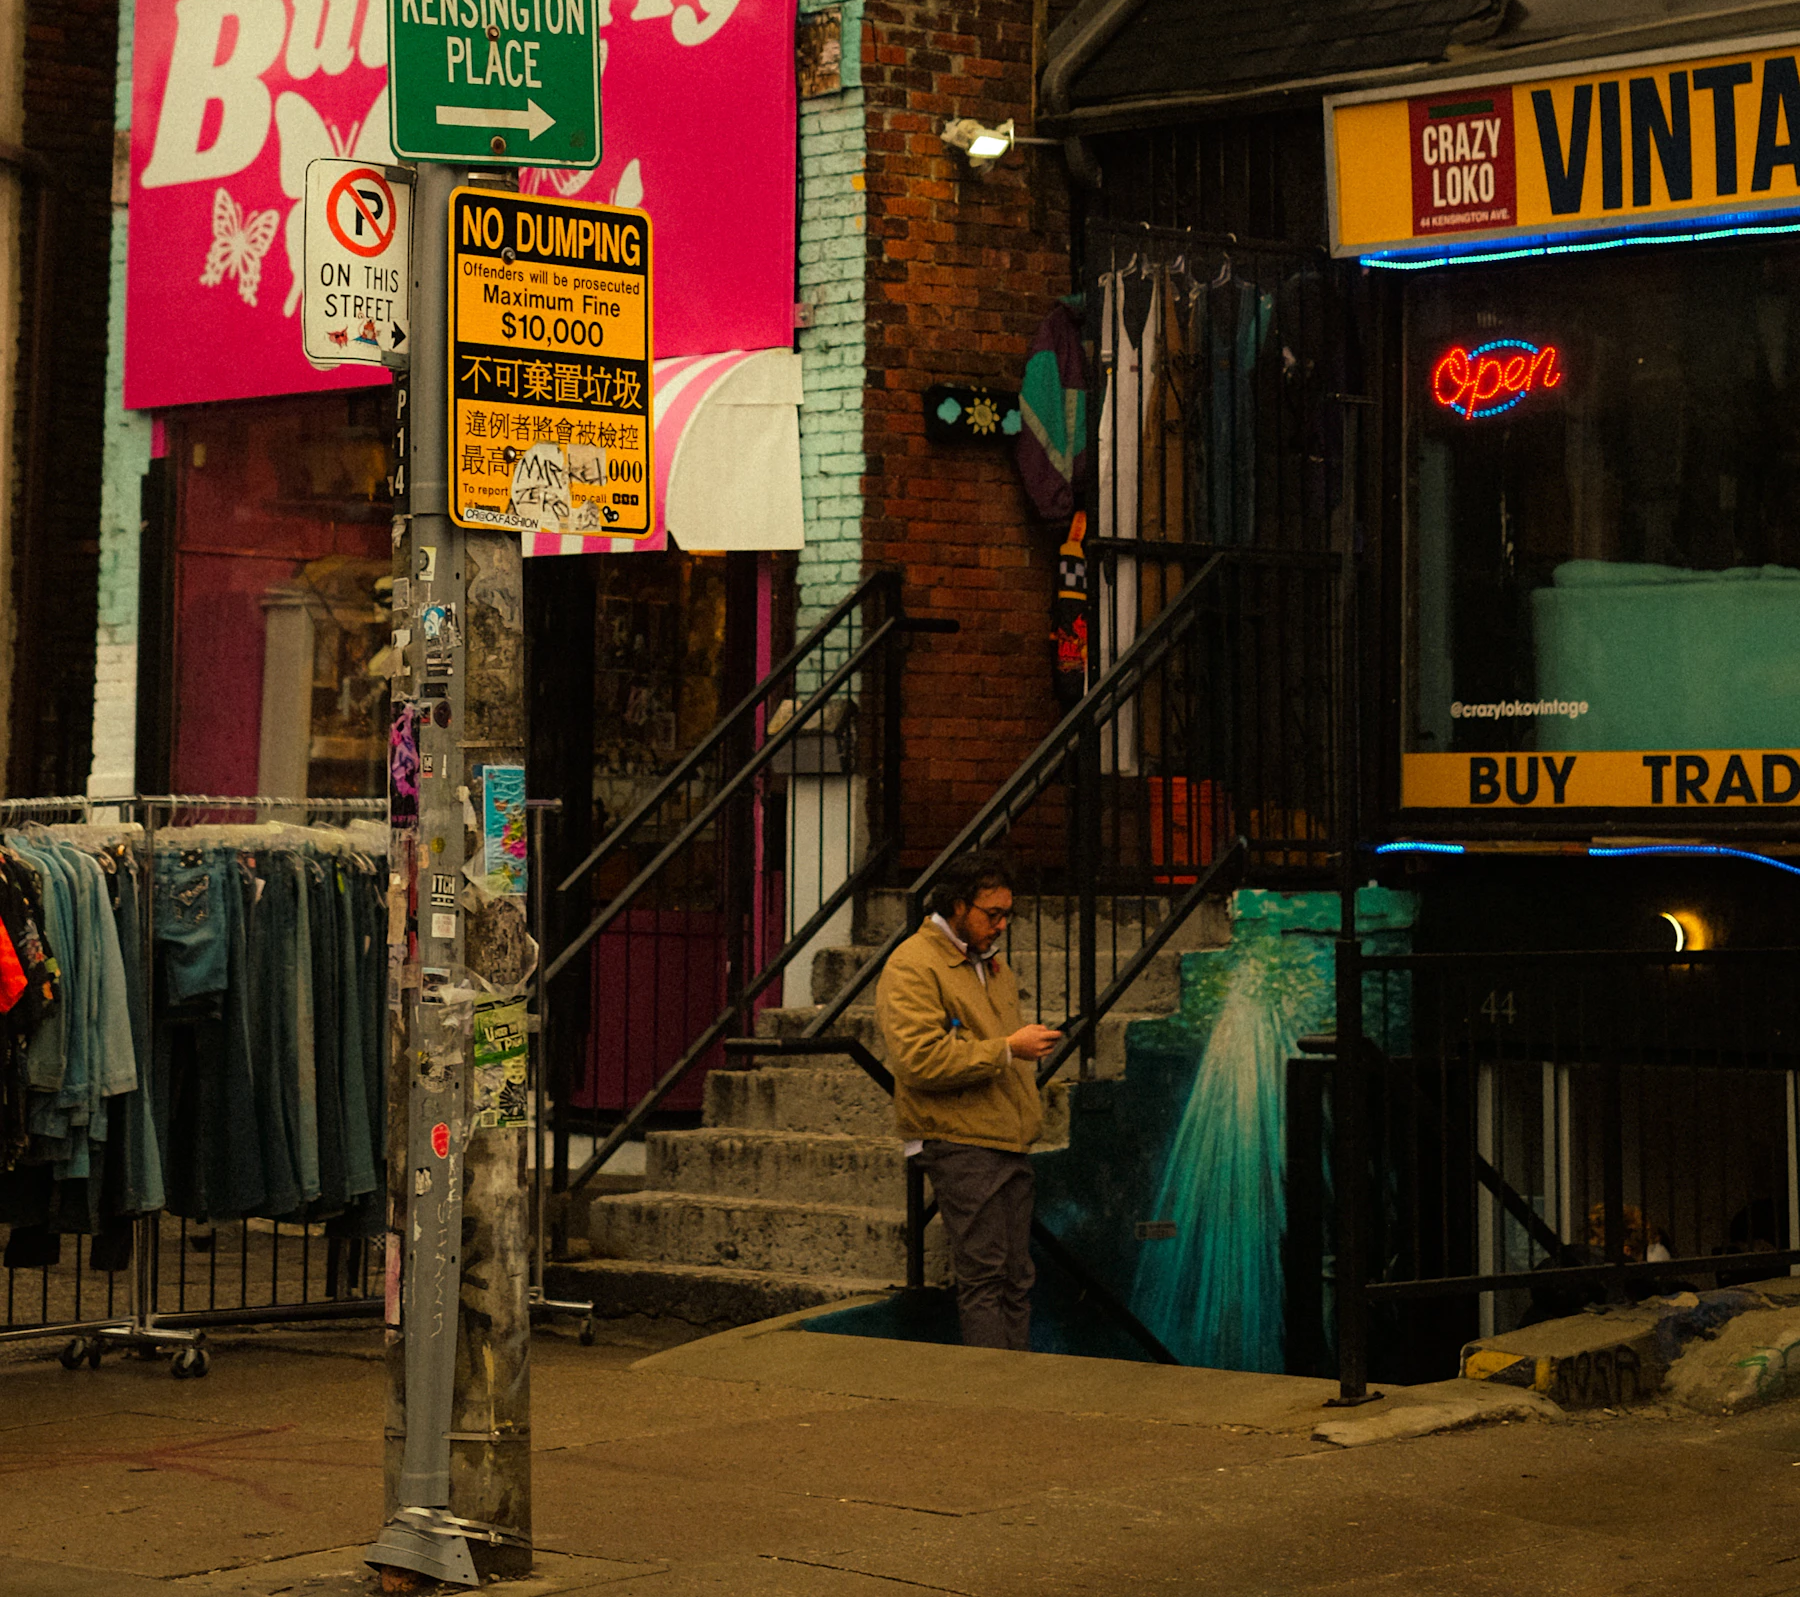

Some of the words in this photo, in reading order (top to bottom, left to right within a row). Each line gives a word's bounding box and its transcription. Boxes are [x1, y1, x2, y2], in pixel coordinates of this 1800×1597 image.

[446, 36, 542, 89] PLACE
[1422, 117, 1501, 166] CRAZY
[1531, 56, 1800, 216] VINTA
[1432, 162, 1495, 208] LOKO
[462, 204, 504, 250] NO
[516, 211, 641, 267] DUMPING
[1431, 211, 1489, 226] KENSINGTON
[320, 262, 351, 287] ON
[364, 265, 399, 293] THIS
[463, 261, 524, 282] Offenders
[530, 272, 549, 285] will
[553, 273, 568, 287] be
[573, 277, 640, 296] prosecuted
[324, 293, 394, 323] STREET
[483, 283, 574, 313] Maximum
[582, 295, 621, 318] Fine
[501, 310, 604, 348] $10,000
[461, 354, 643, 410] 不可棄置垃圾
[1434, 346, 1561, 420] Open
[463, 482, 475, 494] To
[478, 486, 508, 498] report
[590, 493, 607, 504] call
[1450, 698, 1589, 721] @crazylokovintage
[1469, 756, 1578, 805] BUY
[1642, 754, 1800, 805] TRAD
[1481, 990, 1518, 1024] 44
